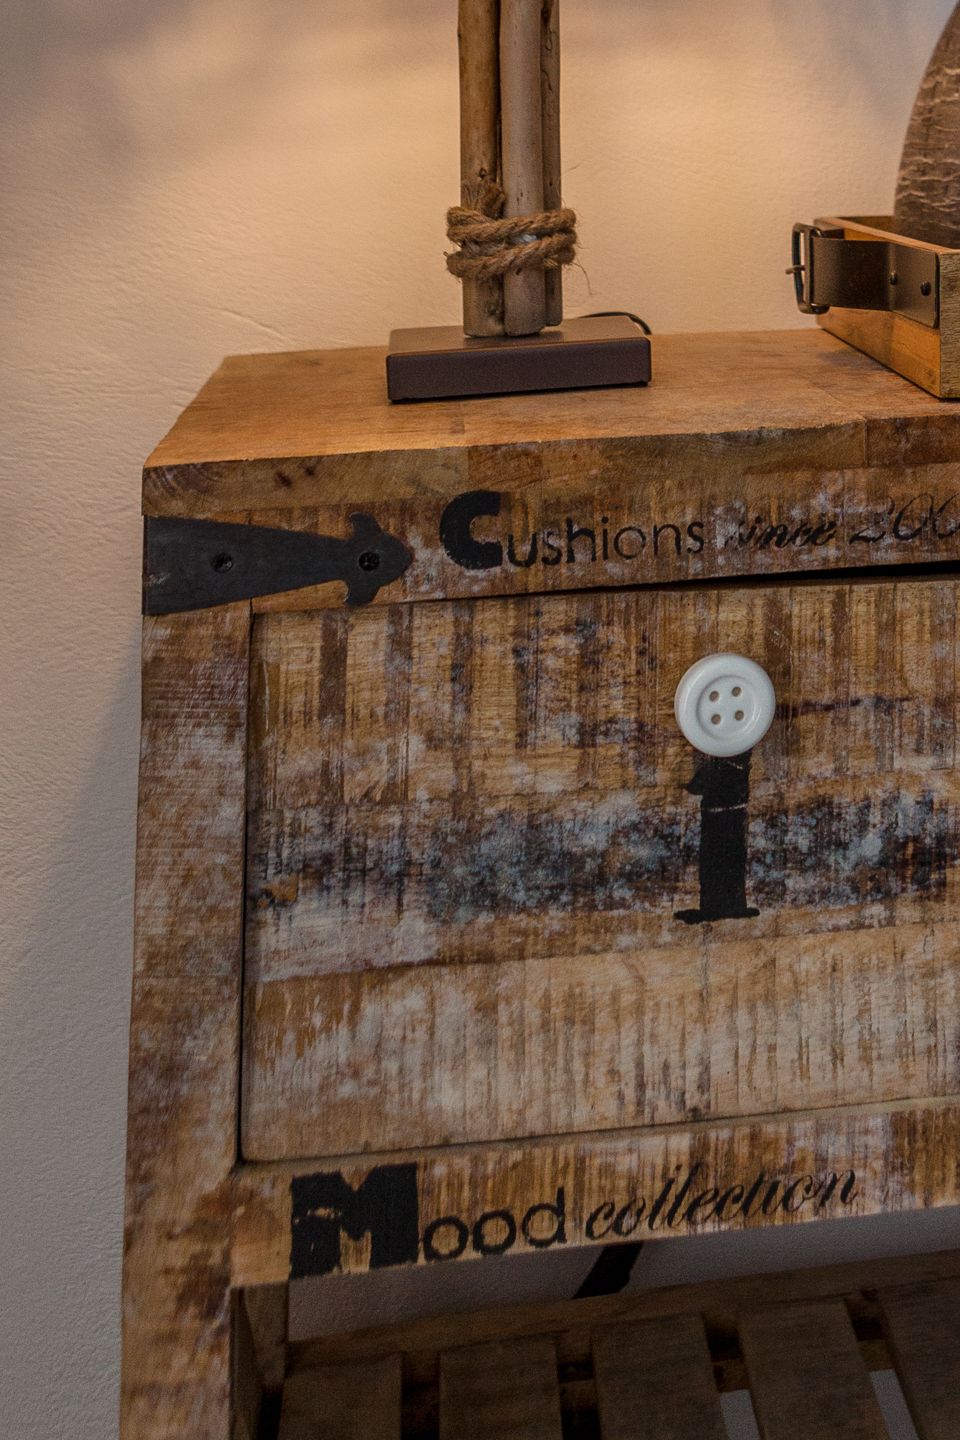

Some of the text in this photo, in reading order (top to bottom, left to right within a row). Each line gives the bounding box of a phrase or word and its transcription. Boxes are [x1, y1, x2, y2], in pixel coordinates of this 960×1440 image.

[439, 489, 704, 570] Cushions
[289, 1162, 859, 1280] Mood collection
